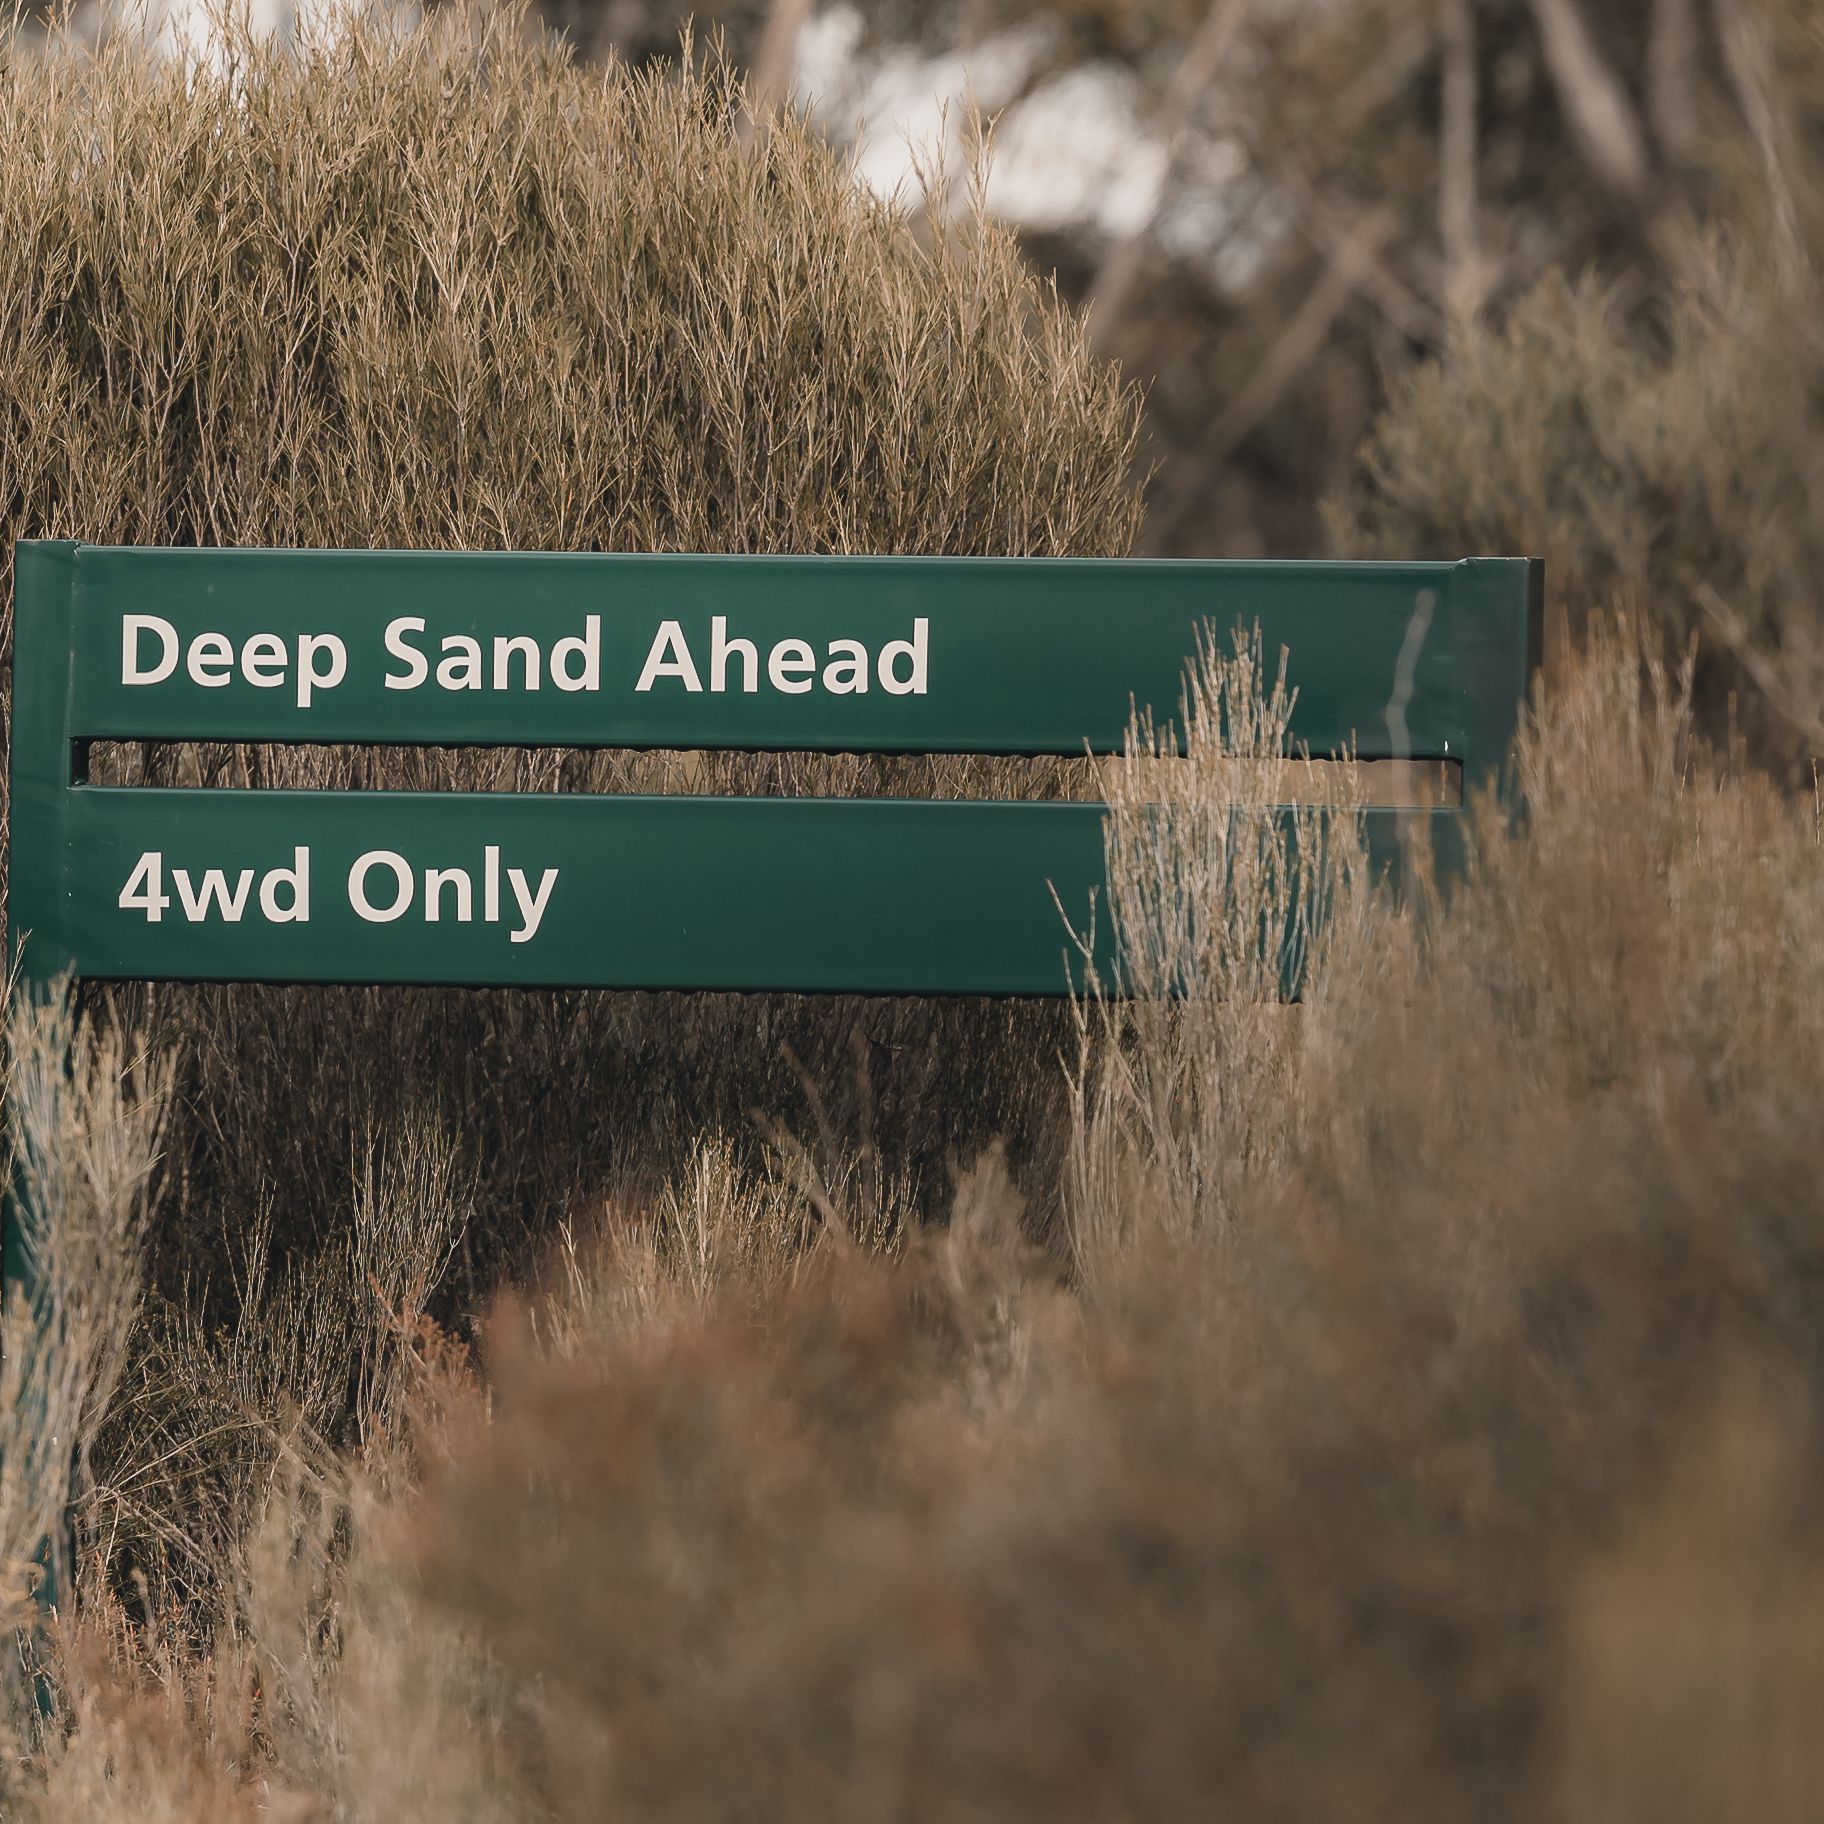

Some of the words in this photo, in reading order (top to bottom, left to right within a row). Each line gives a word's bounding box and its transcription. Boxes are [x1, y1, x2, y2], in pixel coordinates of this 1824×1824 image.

[121, 614, 347, 708] Deep
[384, 614, 601, 692] Sand
[634, 615, 929, 695] Ahead
[118, 845, 310, 923] 4wd
[347, 845, 559, 943] Only
